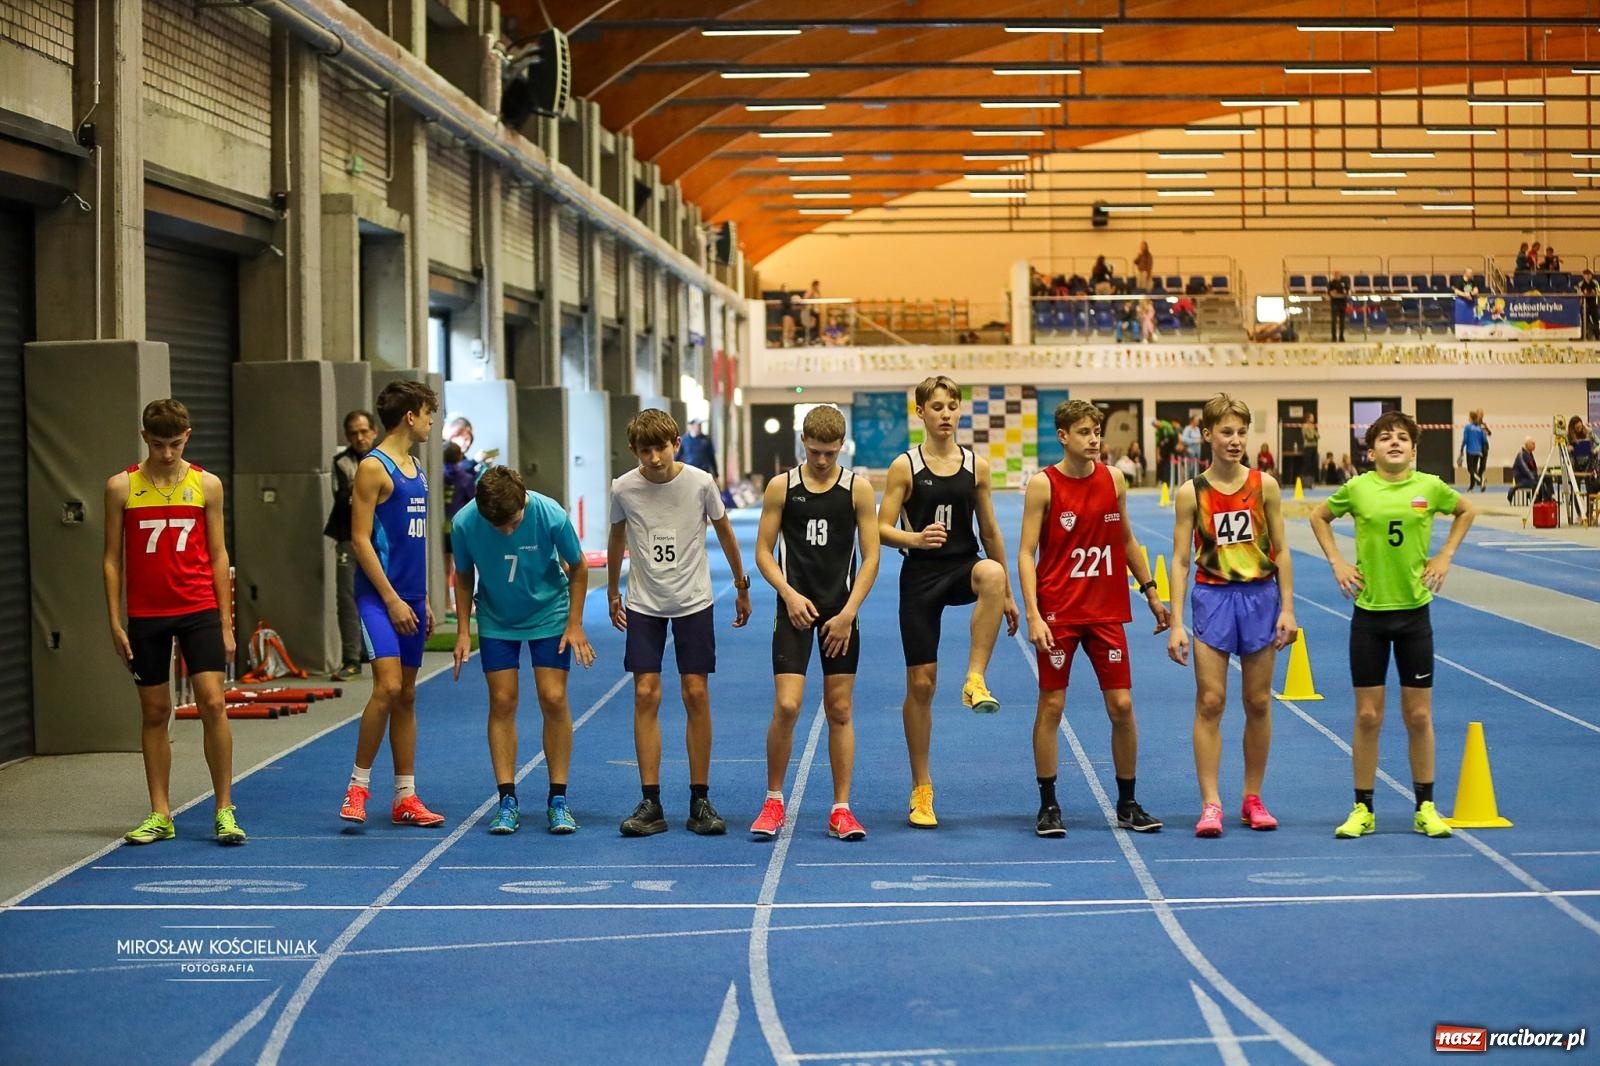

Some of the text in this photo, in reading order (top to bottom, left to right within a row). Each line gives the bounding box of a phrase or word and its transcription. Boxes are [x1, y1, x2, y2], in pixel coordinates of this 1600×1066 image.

[1509, 302, 1563, 313] Lekkoatletyka
[934, 504, 953, 531] 41
[1216, 511, 1251, 542] 42
[138, 518, 196, 553] 77
[806, 518, 828, 546] 43
[1388, 520, 1404, 547] 5
[653, 545, 676, 563] 35
[1070, 545, 1113, 579] 221
[504, 554, 518, 583] 7
